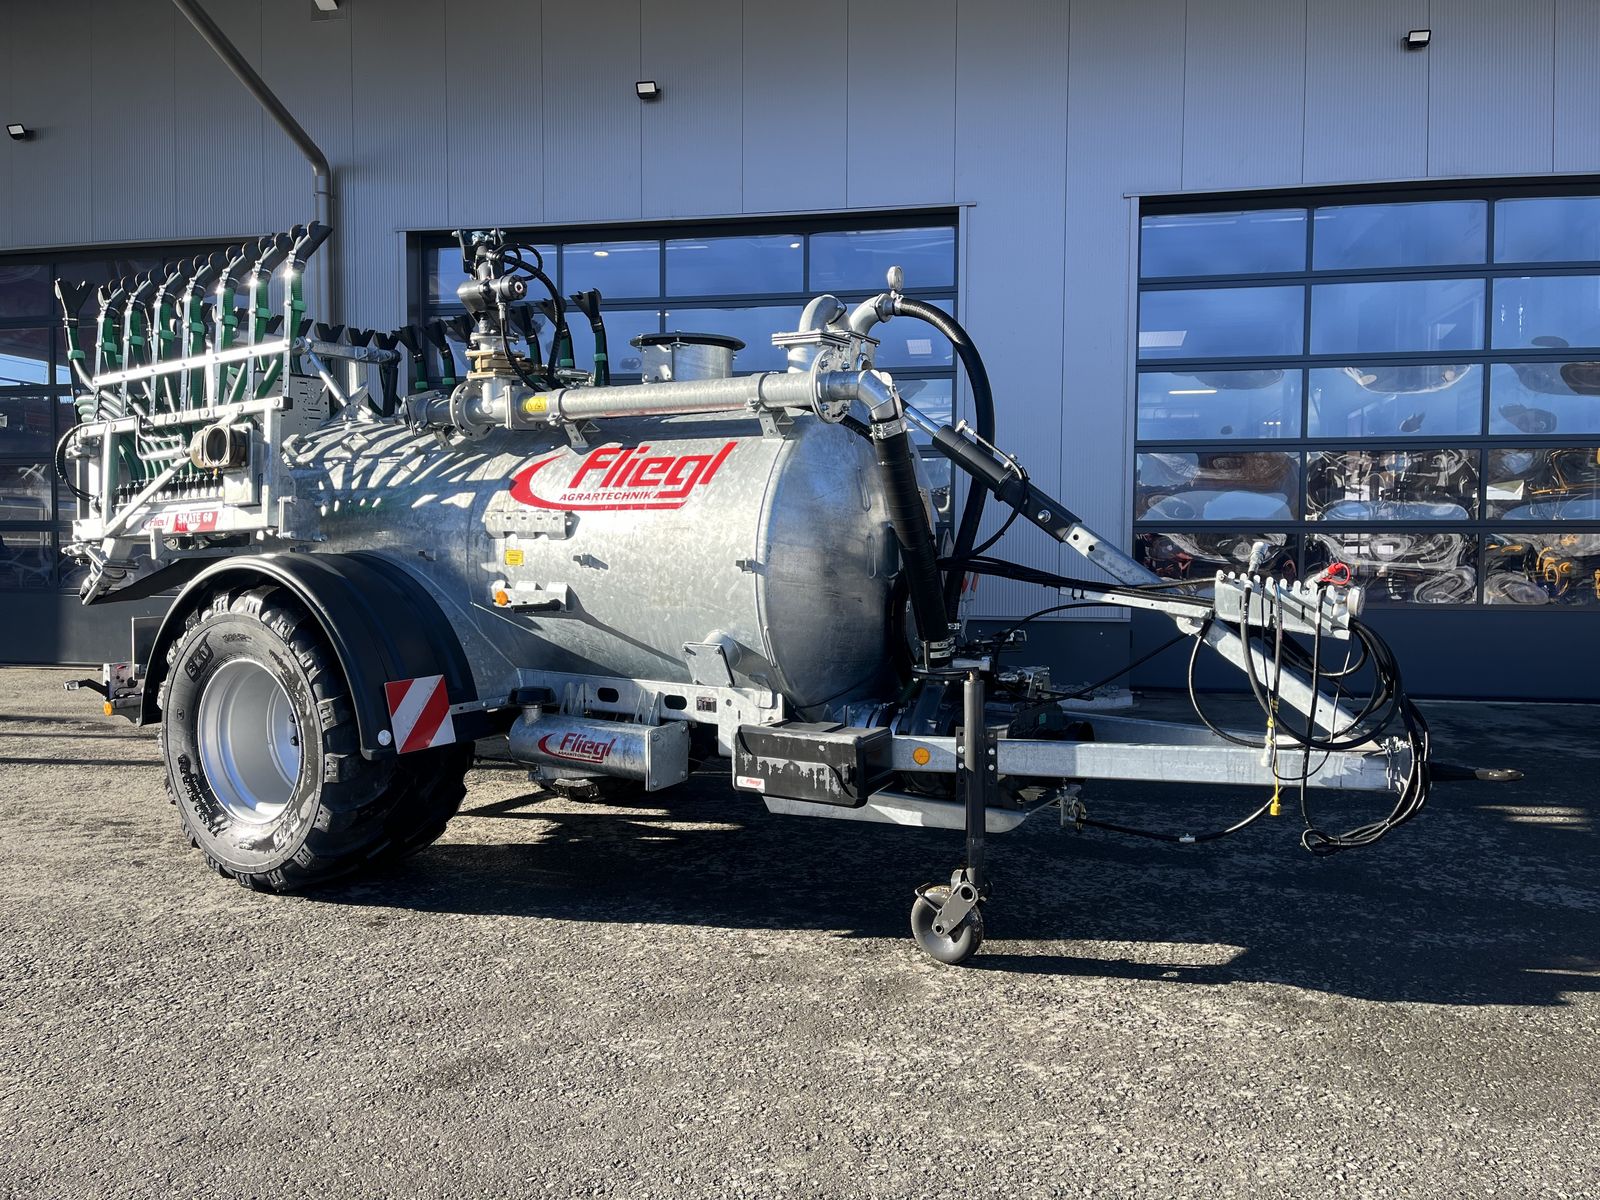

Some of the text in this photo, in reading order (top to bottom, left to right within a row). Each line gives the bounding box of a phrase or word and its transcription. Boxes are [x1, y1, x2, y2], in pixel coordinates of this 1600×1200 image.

[568, 441, 738, 498] Fliegl
[559, 490, 652, 502] AGRARTECHNIK
[177, 512, 201, 524] SKATE
[560, 732, 617, 760] Fliegl
